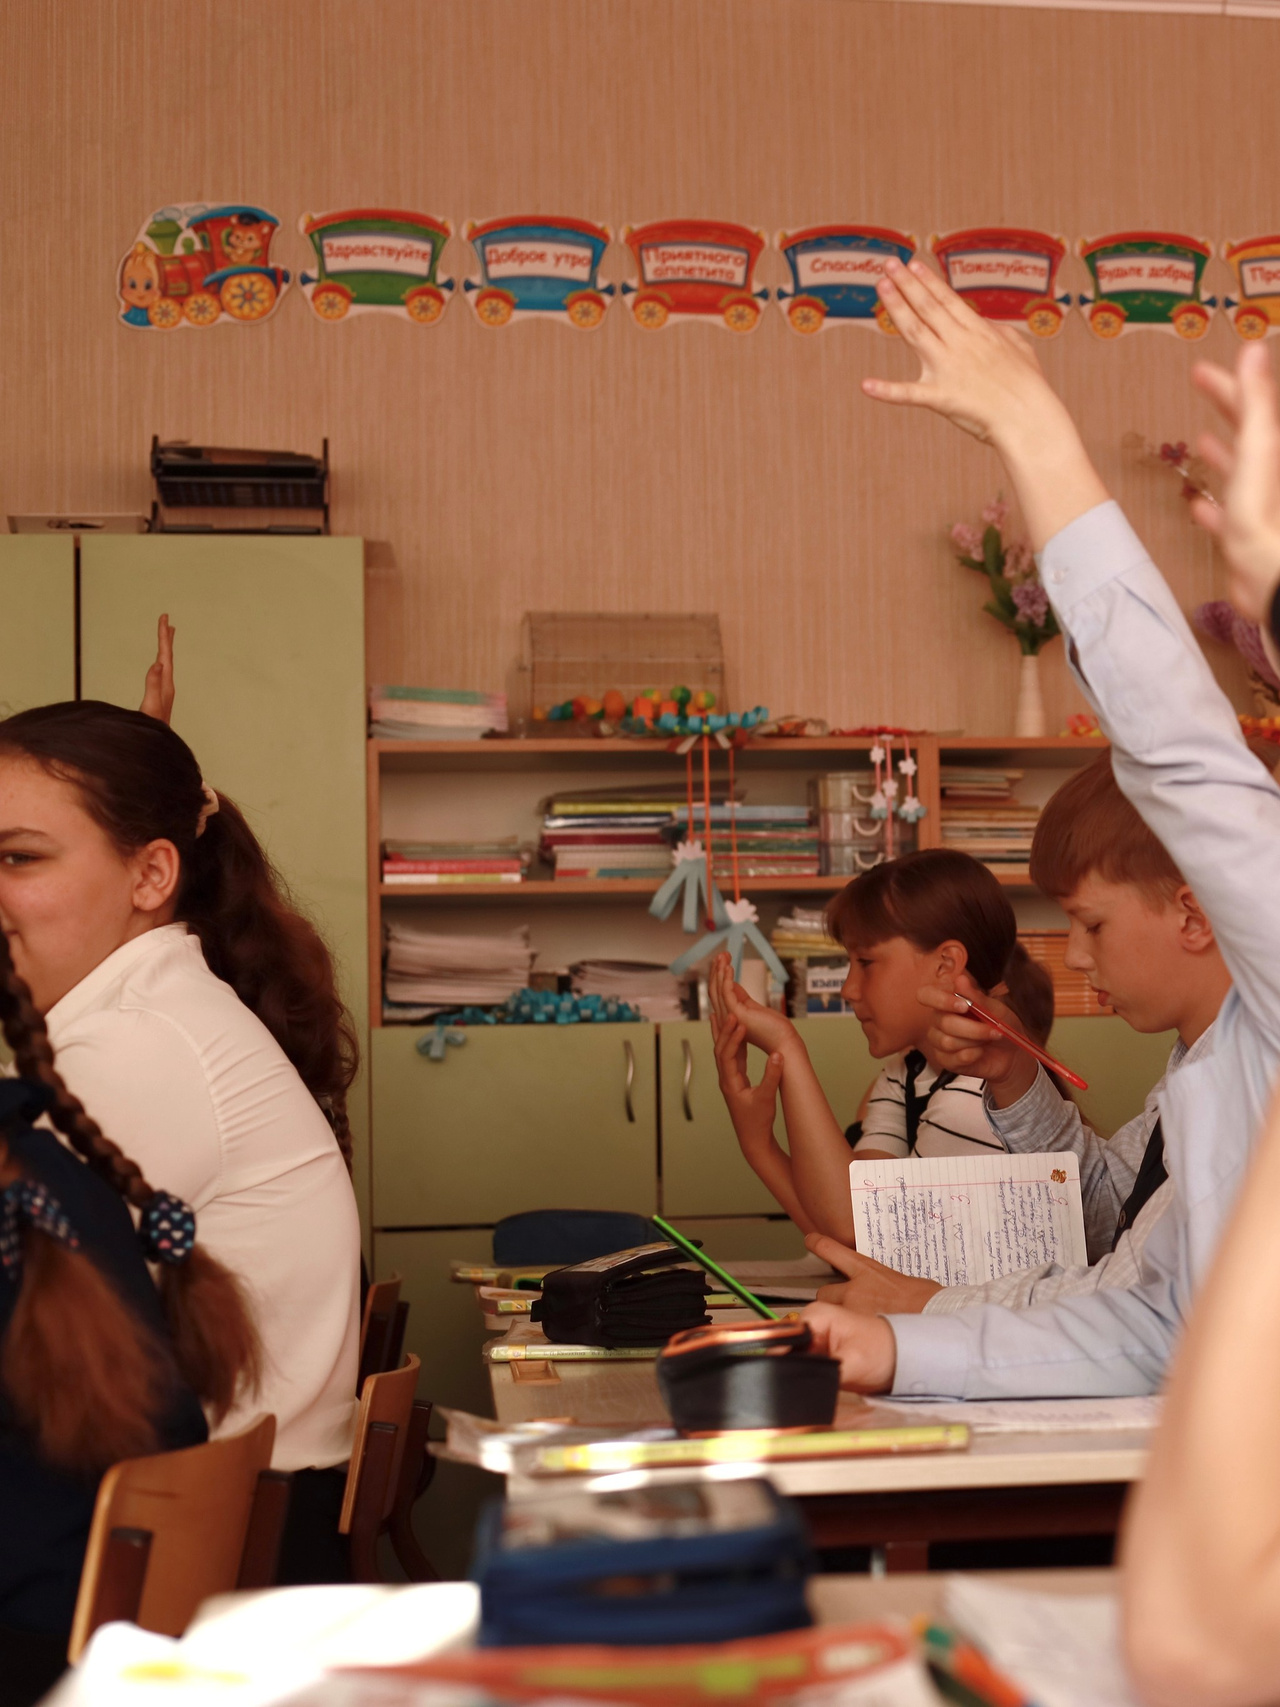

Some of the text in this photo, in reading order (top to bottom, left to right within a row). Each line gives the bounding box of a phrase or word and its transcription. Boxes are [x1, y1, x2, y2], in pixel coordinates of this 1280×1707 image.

[324, 242, 430, 262] Здравствуйте
[487, 247, 592, 268] Доброе утро
[645, 248, 746, 267] Приятного
[653, 265, 735, 281] аппетита
[810, 257, 884, 275] Спасибо
[951, 259, 1047, 278] Пожалуйста
[1098, 264, 1144, 281] Будьте
